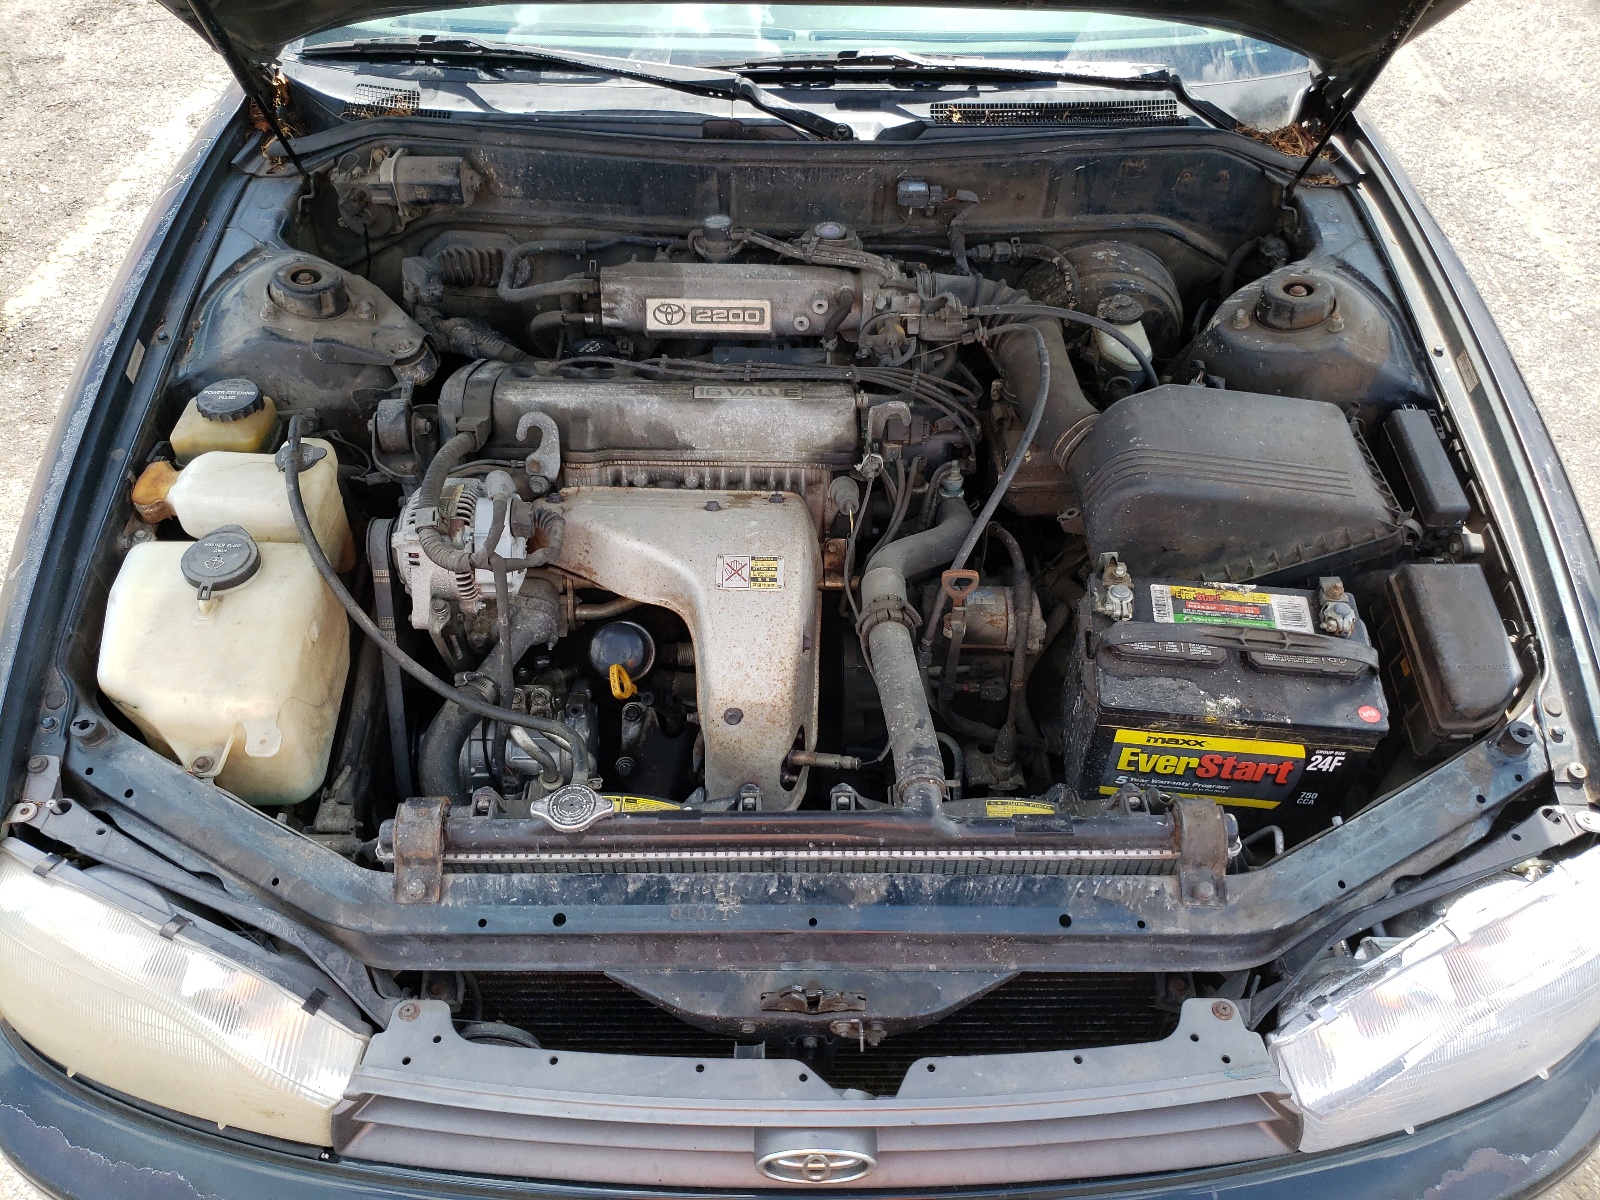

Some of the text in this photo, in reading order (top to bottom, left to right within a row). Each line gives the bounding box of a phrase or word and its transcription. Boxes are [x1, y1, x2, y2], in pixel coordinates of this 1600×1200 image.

[695, 309, 760, 322] 2200
[697, 387, 799, 398] 16 VALVE
[1175, 590, 1221, 602] EverStart
[1146, 736, 1207, 747] maxx
[1116, 747, 1294, 785] EverStart
[1306, 755, 1346, 772] 24F
[1115, 775, 1129, 785] 5
[1151, 778, 1190, 788] Warranty
[1300, 791, 1318, 799] 750
[1297, 798, 1314, 806] CCA
